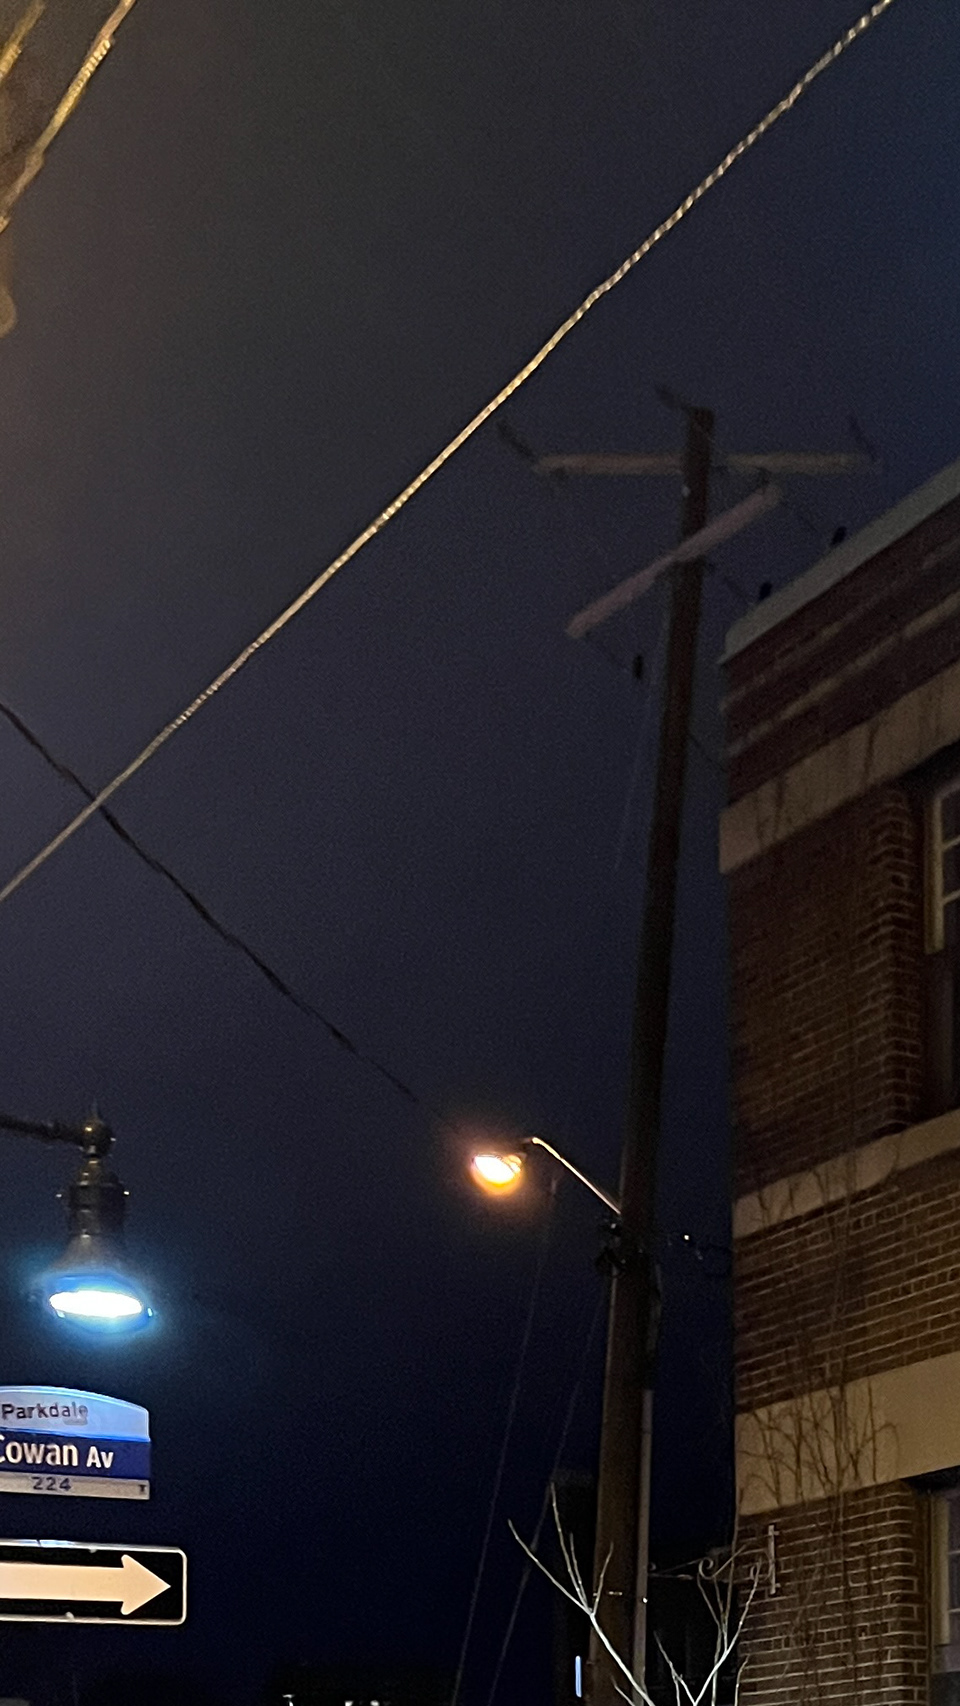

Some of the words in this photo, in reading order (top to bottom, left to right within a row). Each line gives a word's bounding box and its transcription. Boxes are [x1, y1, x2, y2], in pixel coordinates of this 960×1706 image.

[1, 1402, 89, 1420] Parkdale
[86, 1446, 114, 1468] Av
[31, 1476, 72, 1491] 224
